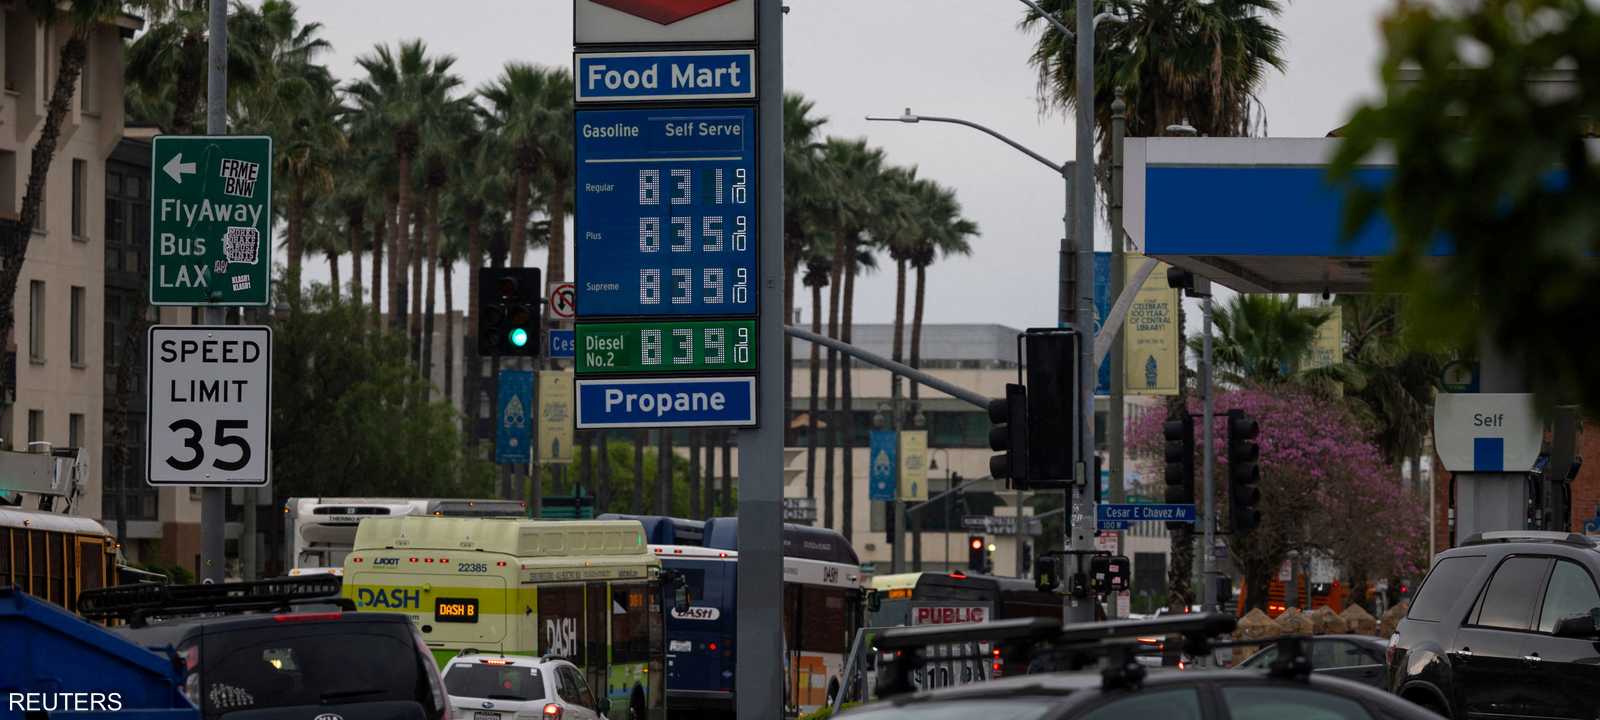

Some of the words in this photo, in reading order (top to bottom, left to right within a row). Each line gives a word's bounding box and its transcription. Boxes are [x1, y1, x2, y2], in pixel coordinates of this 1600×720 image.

[588, 63, 658, 90] Food
[671, 61, 741, 89] Mart
[583, 123, 639, 138] Gasoline
[665, 122, 693, 137] Self
[699, 122, 741, 136] Serve
[221, 159, 258, 180] FRME
[225, 178, 255, 197] BNW
[585, 183, 614, 193] Regular
[639, 168, 723, 205] 831
[160, 199, 263, 228] FlyAway
[160, 232, 206, 256] Bus
[586, 231, 601, 240] Plus
[639, 216, 723, 252] 835
[159, 264, 208, 288] LAX
[586, 282, 619, 292] Supreme
[639, 268, 724, 304] 839
[161, 340, 260, 363] SPEED
[586, 335, 624, 350] Diesel
[641, 328, 725, 365] 839
[586, 352, 614, 367] No.2
[171, 379, 248, 403] LIMIT
[605, 389, 725, 417] Propane
[1473, 413, 1504, 427] Self
[165, 419, 251, 471] 35
[1106, 506, 1130, 518] Cesar
[1134, 507, 1140, 518] E
[1175, 507, 1186, 518] Av
[1103, 521, 1115, 529] 100
[458, 563, 487, 572] 22385
[823, 566, 839, 584] DASH
[358, 588, 420, 609] DASH
[439, 604, 465, 616] DASH
[467, 604, 474, 616] B
[677, 608, 713, 619] DASH
[918, 607, 984, 625] PUBLIC
[546, 617, 577, 657] DASH
